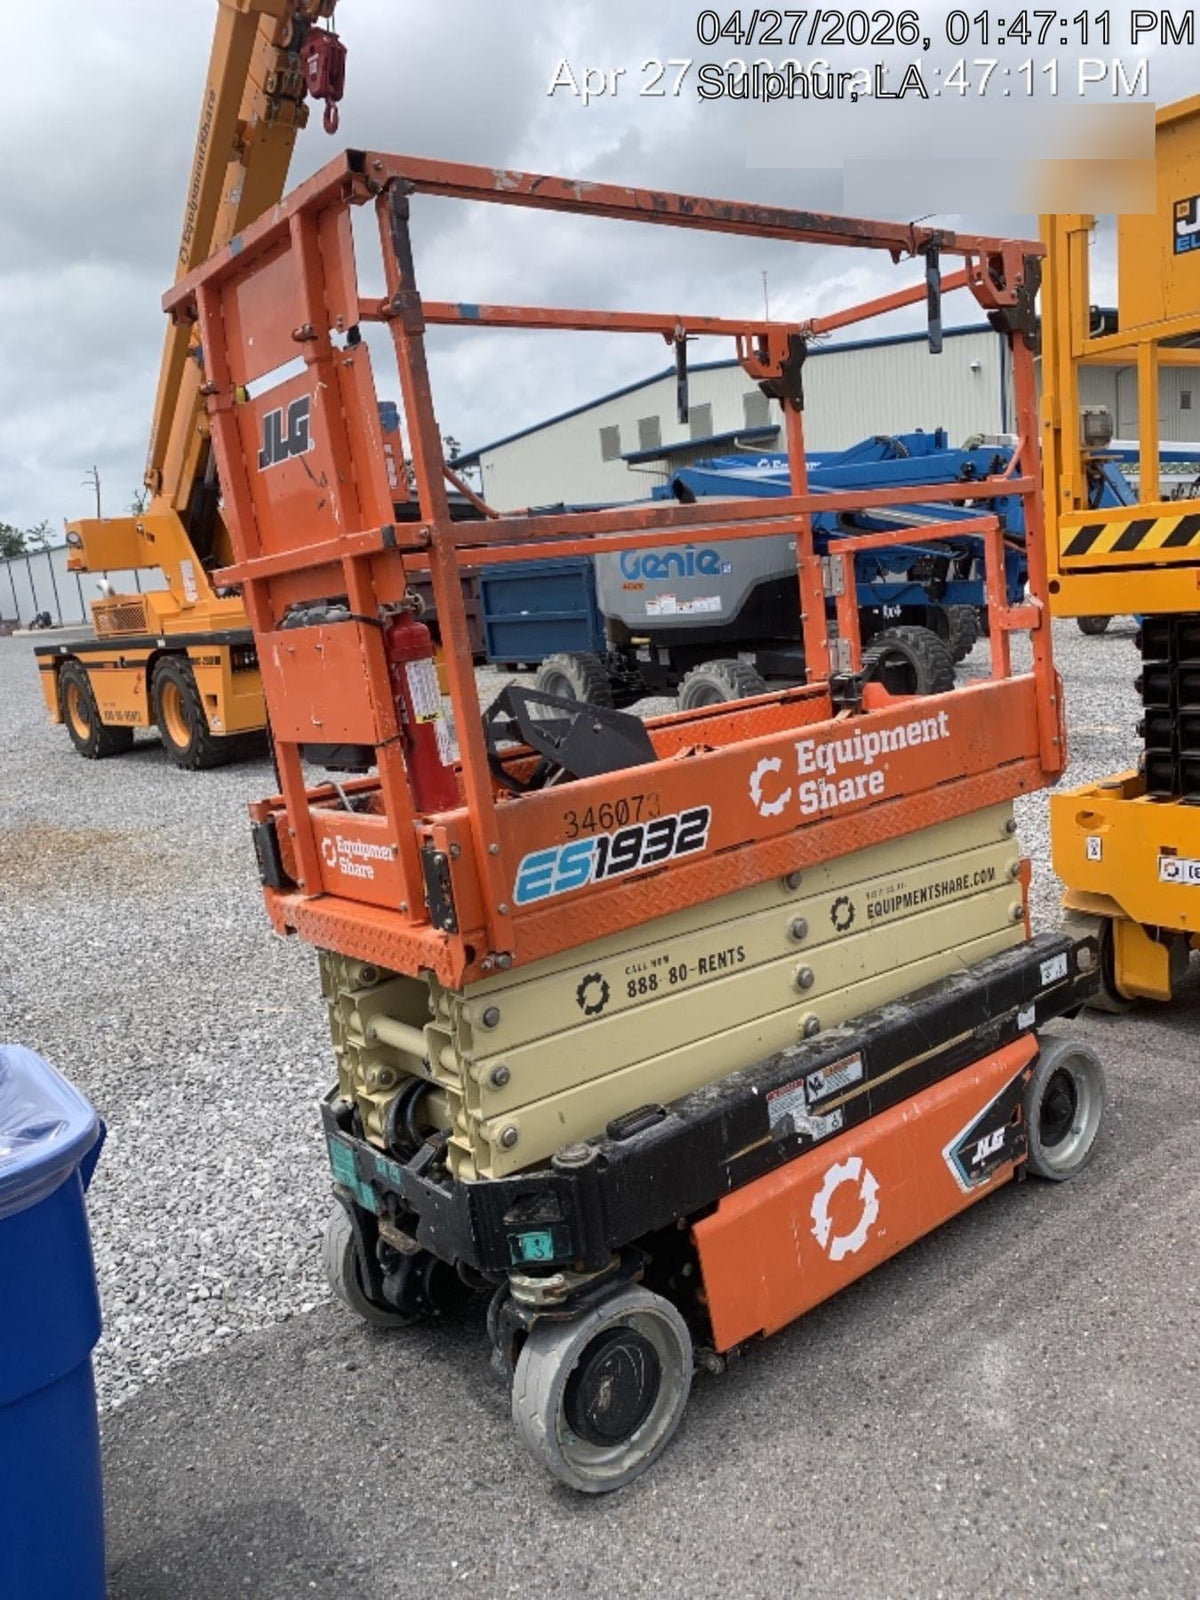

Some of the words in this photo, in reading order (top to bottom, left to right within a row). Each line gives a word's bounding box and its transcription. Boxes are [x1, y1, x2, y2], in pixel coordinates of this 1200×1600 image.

[258, 393, 312, 472] JLG
[620, 543, 721, 580] Genie
[795, 710, 950, 775] Equipment
[799, 769, 885, 815] Share
[514, 804, 711, 905] ES1932
[867, 866, 996, 919] EQUIPMENTSHARE.COM
